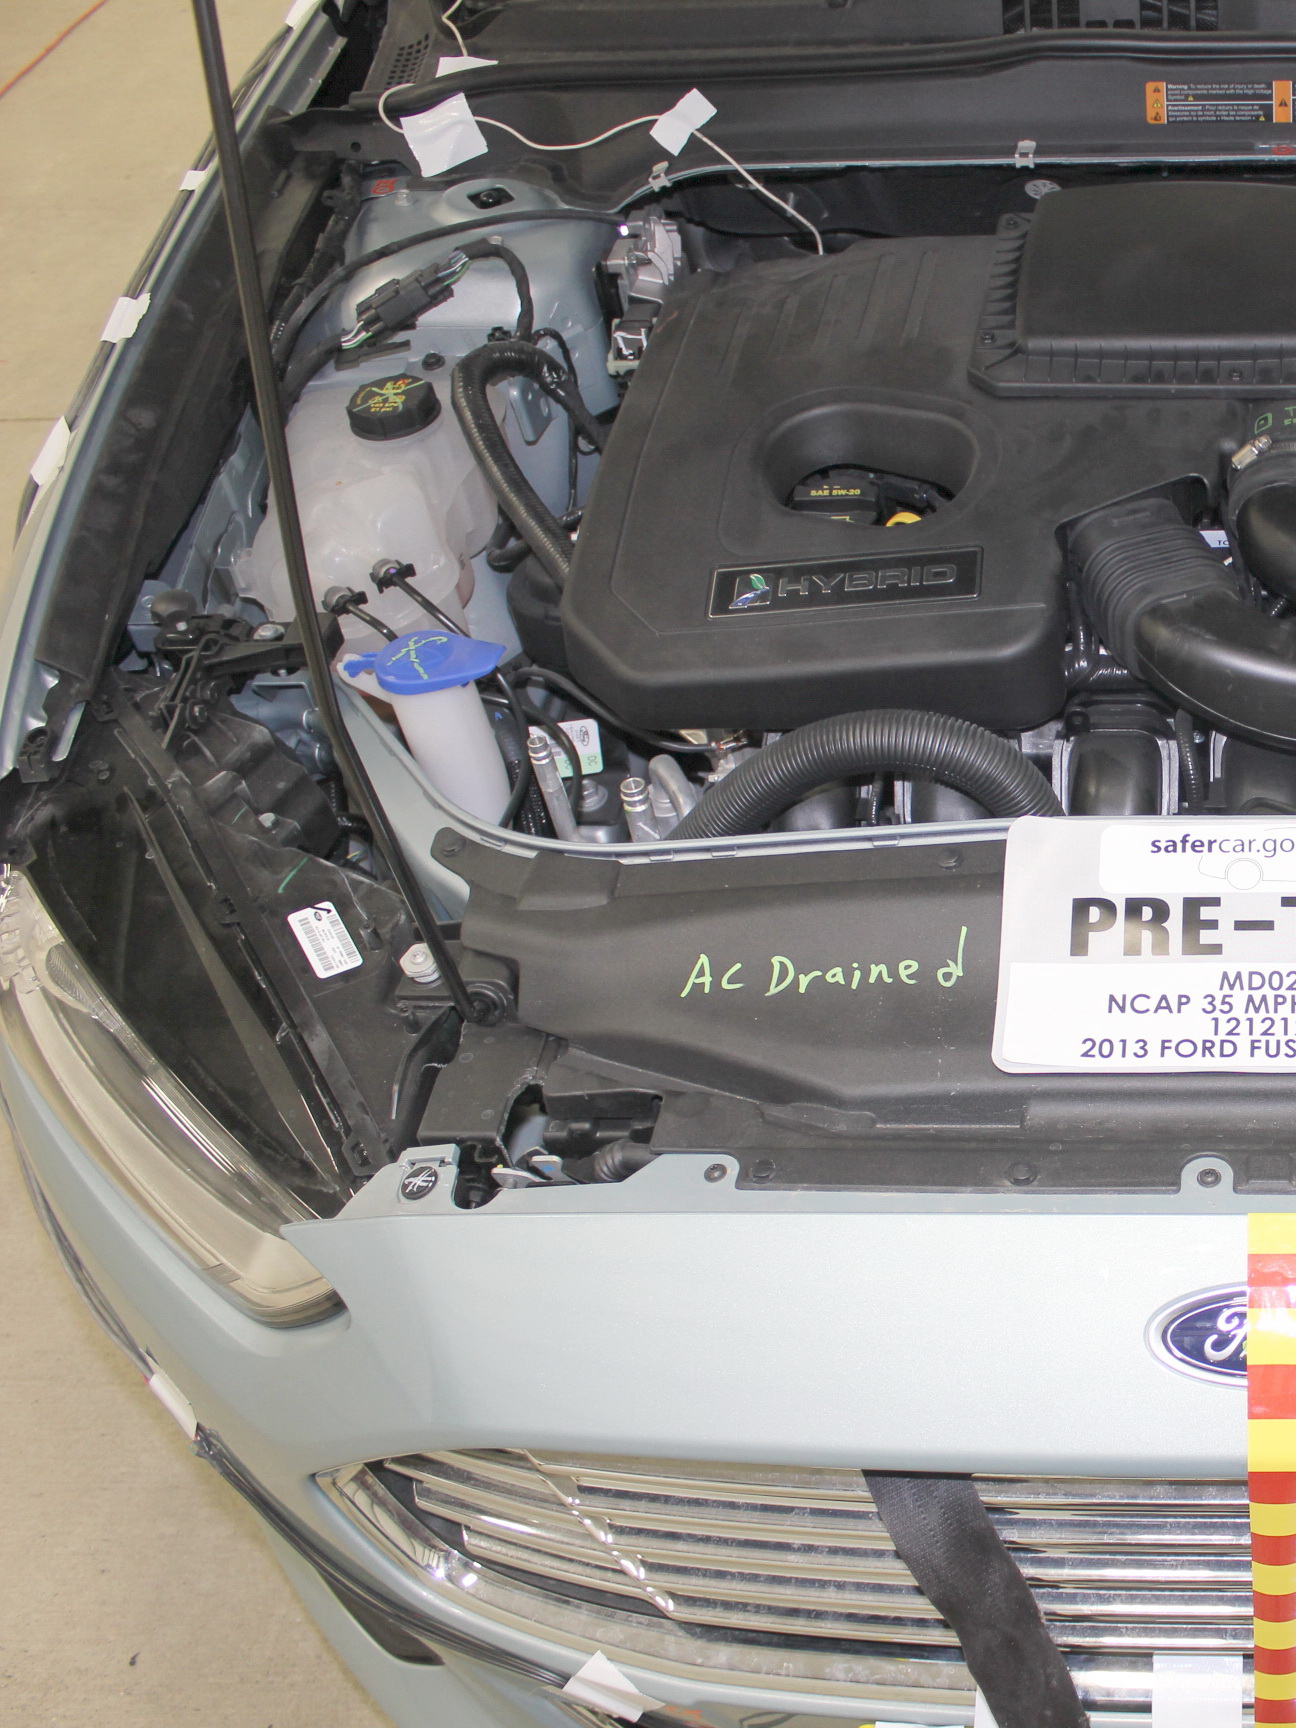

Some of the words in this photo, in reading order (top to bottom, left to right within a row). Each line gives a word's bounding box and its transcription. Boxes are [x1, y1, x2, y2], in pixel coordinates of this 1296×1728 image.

[777, 564, 957, 597] HYBRID
[1107, 994, 1191, 1014] NCAP
[1201, 994, 1234, 1014] 35
[1080, 1038, 1149, 1059] 2013
[1160, 1038, 1238, 1058] FORD
